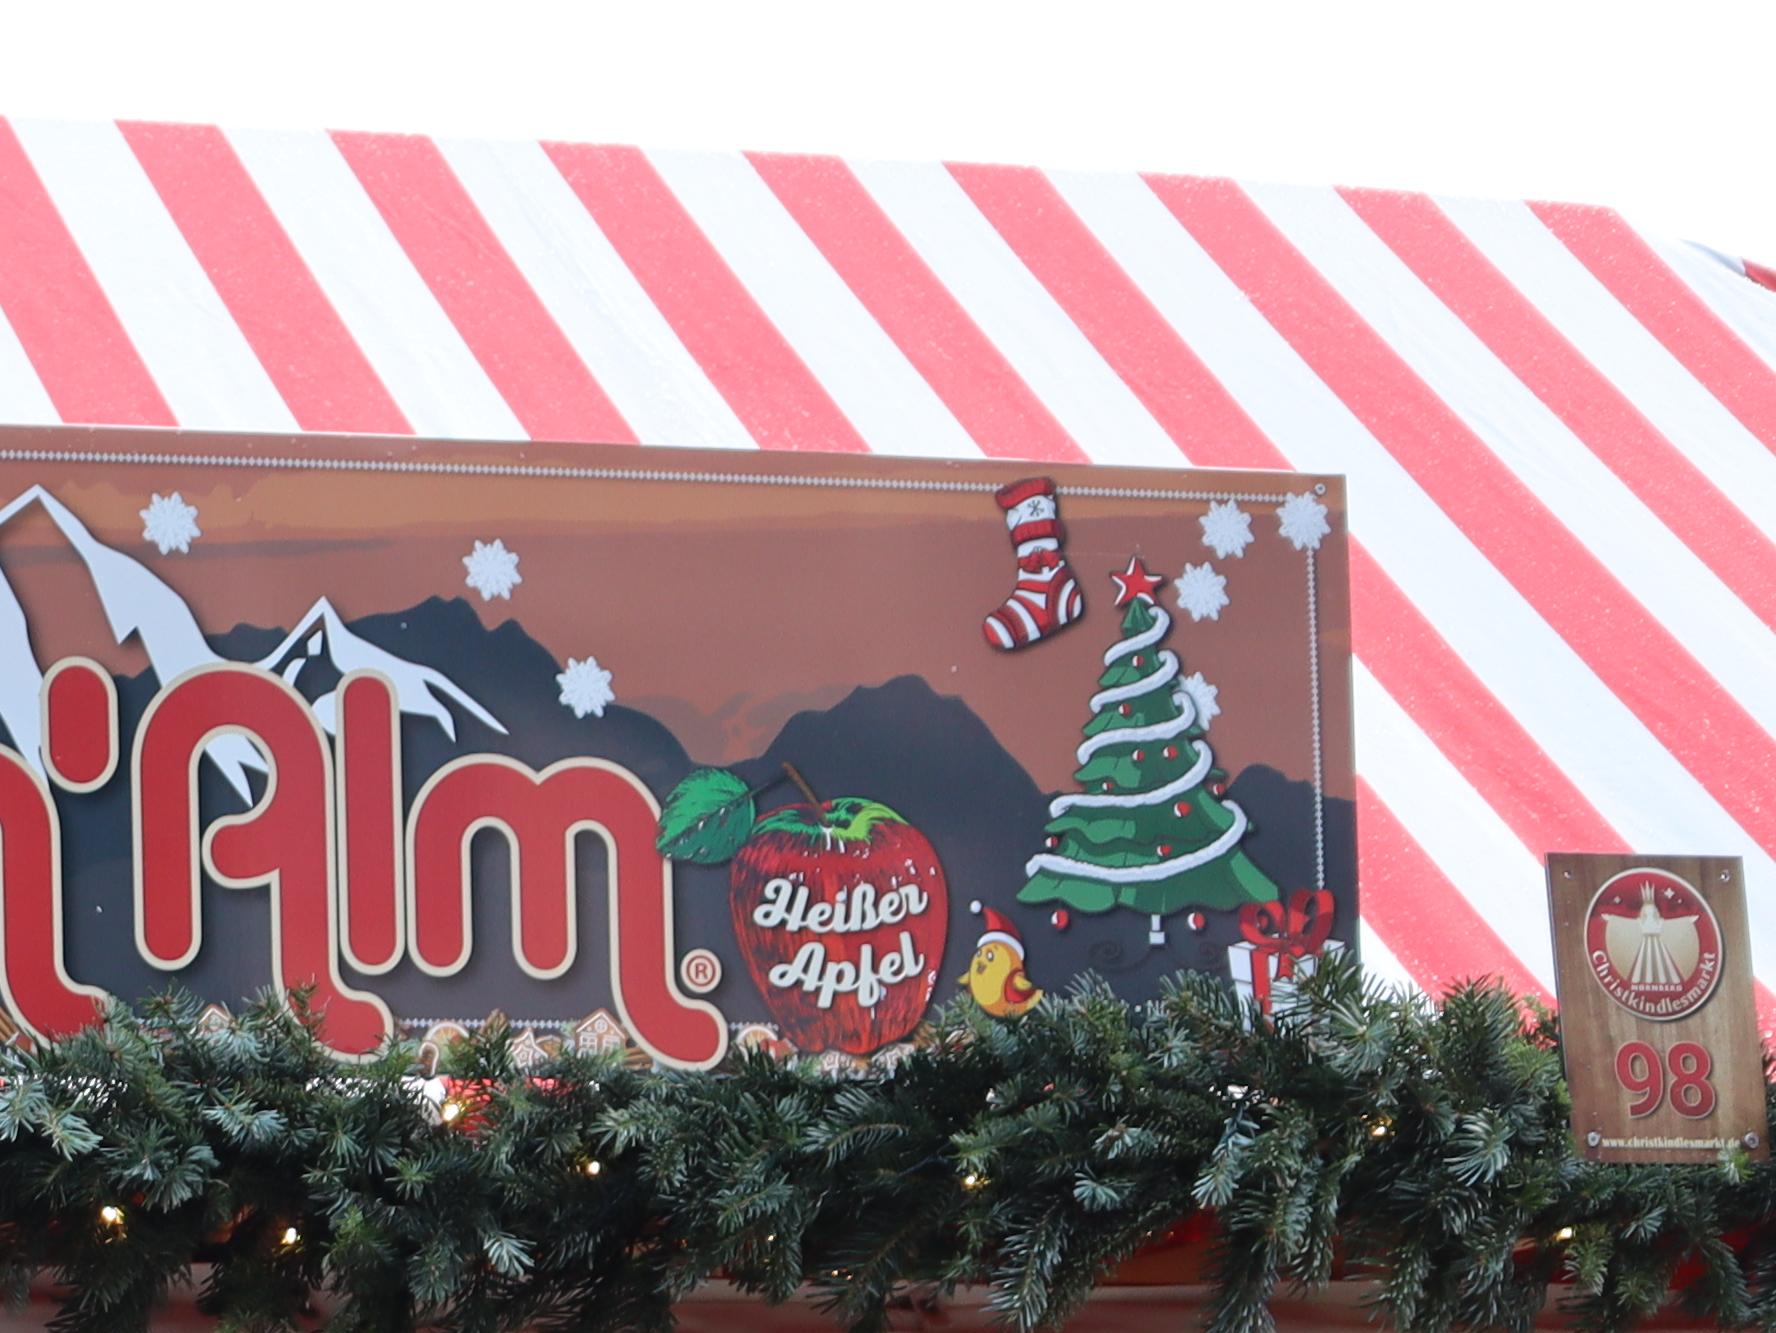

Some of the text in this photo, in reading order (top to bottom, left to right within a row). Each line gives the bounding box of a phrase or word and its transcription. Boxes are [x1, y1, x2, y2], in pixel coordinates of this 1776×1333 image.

[753, 878, 928, 933] Heißer
[768, 932, 924, 1009] Apfel
[1592, 950, 1716, 1014] Christkindlesmarkt
[1615, 1041, 1715, 1119] 98
[1602, 1136, 1741, 1149] www.christkindlesmarkt.de
